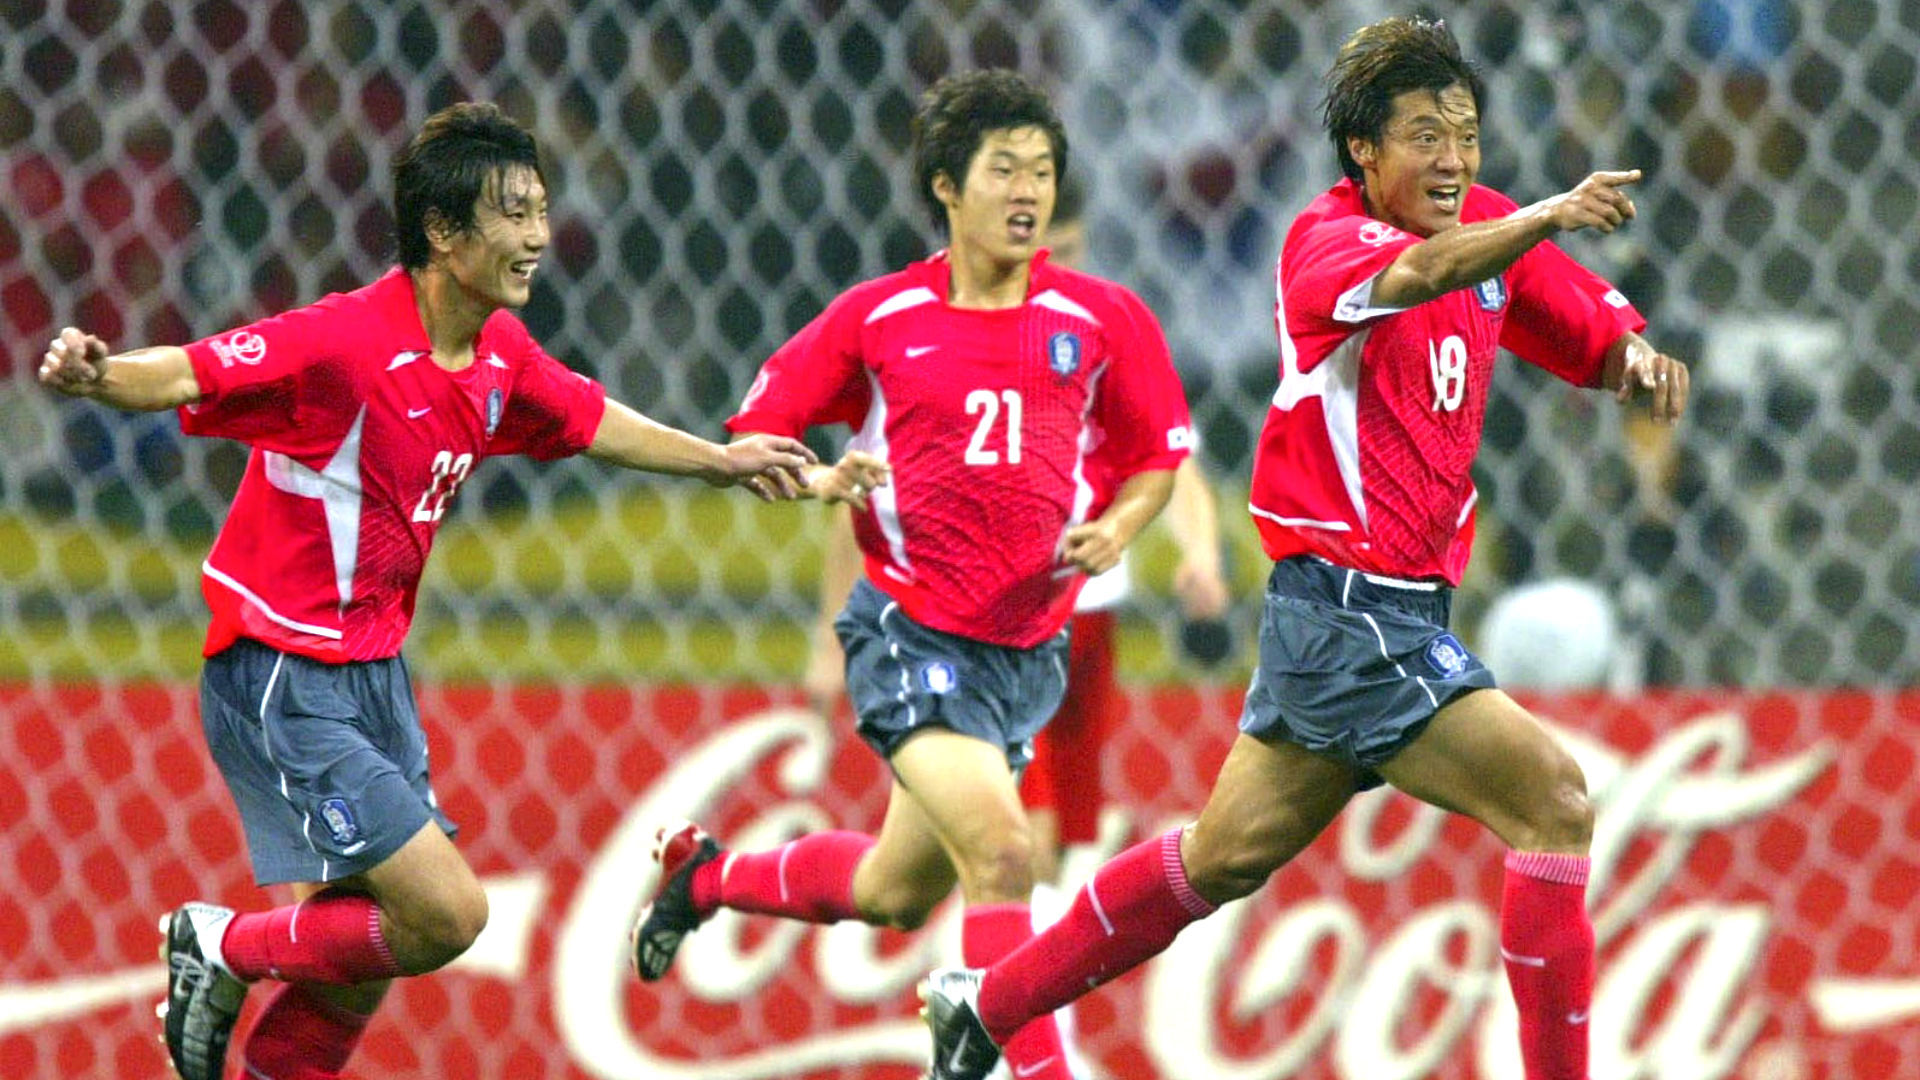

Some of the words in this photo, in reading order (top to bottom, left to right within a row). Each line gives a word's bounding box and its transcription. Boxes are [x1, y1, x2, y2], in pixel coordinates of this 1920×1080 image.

[965, 389, 1021, 466] 21
[412, 450, 473, 522] 22
[553, 708, 1836, 1080] CocCola
